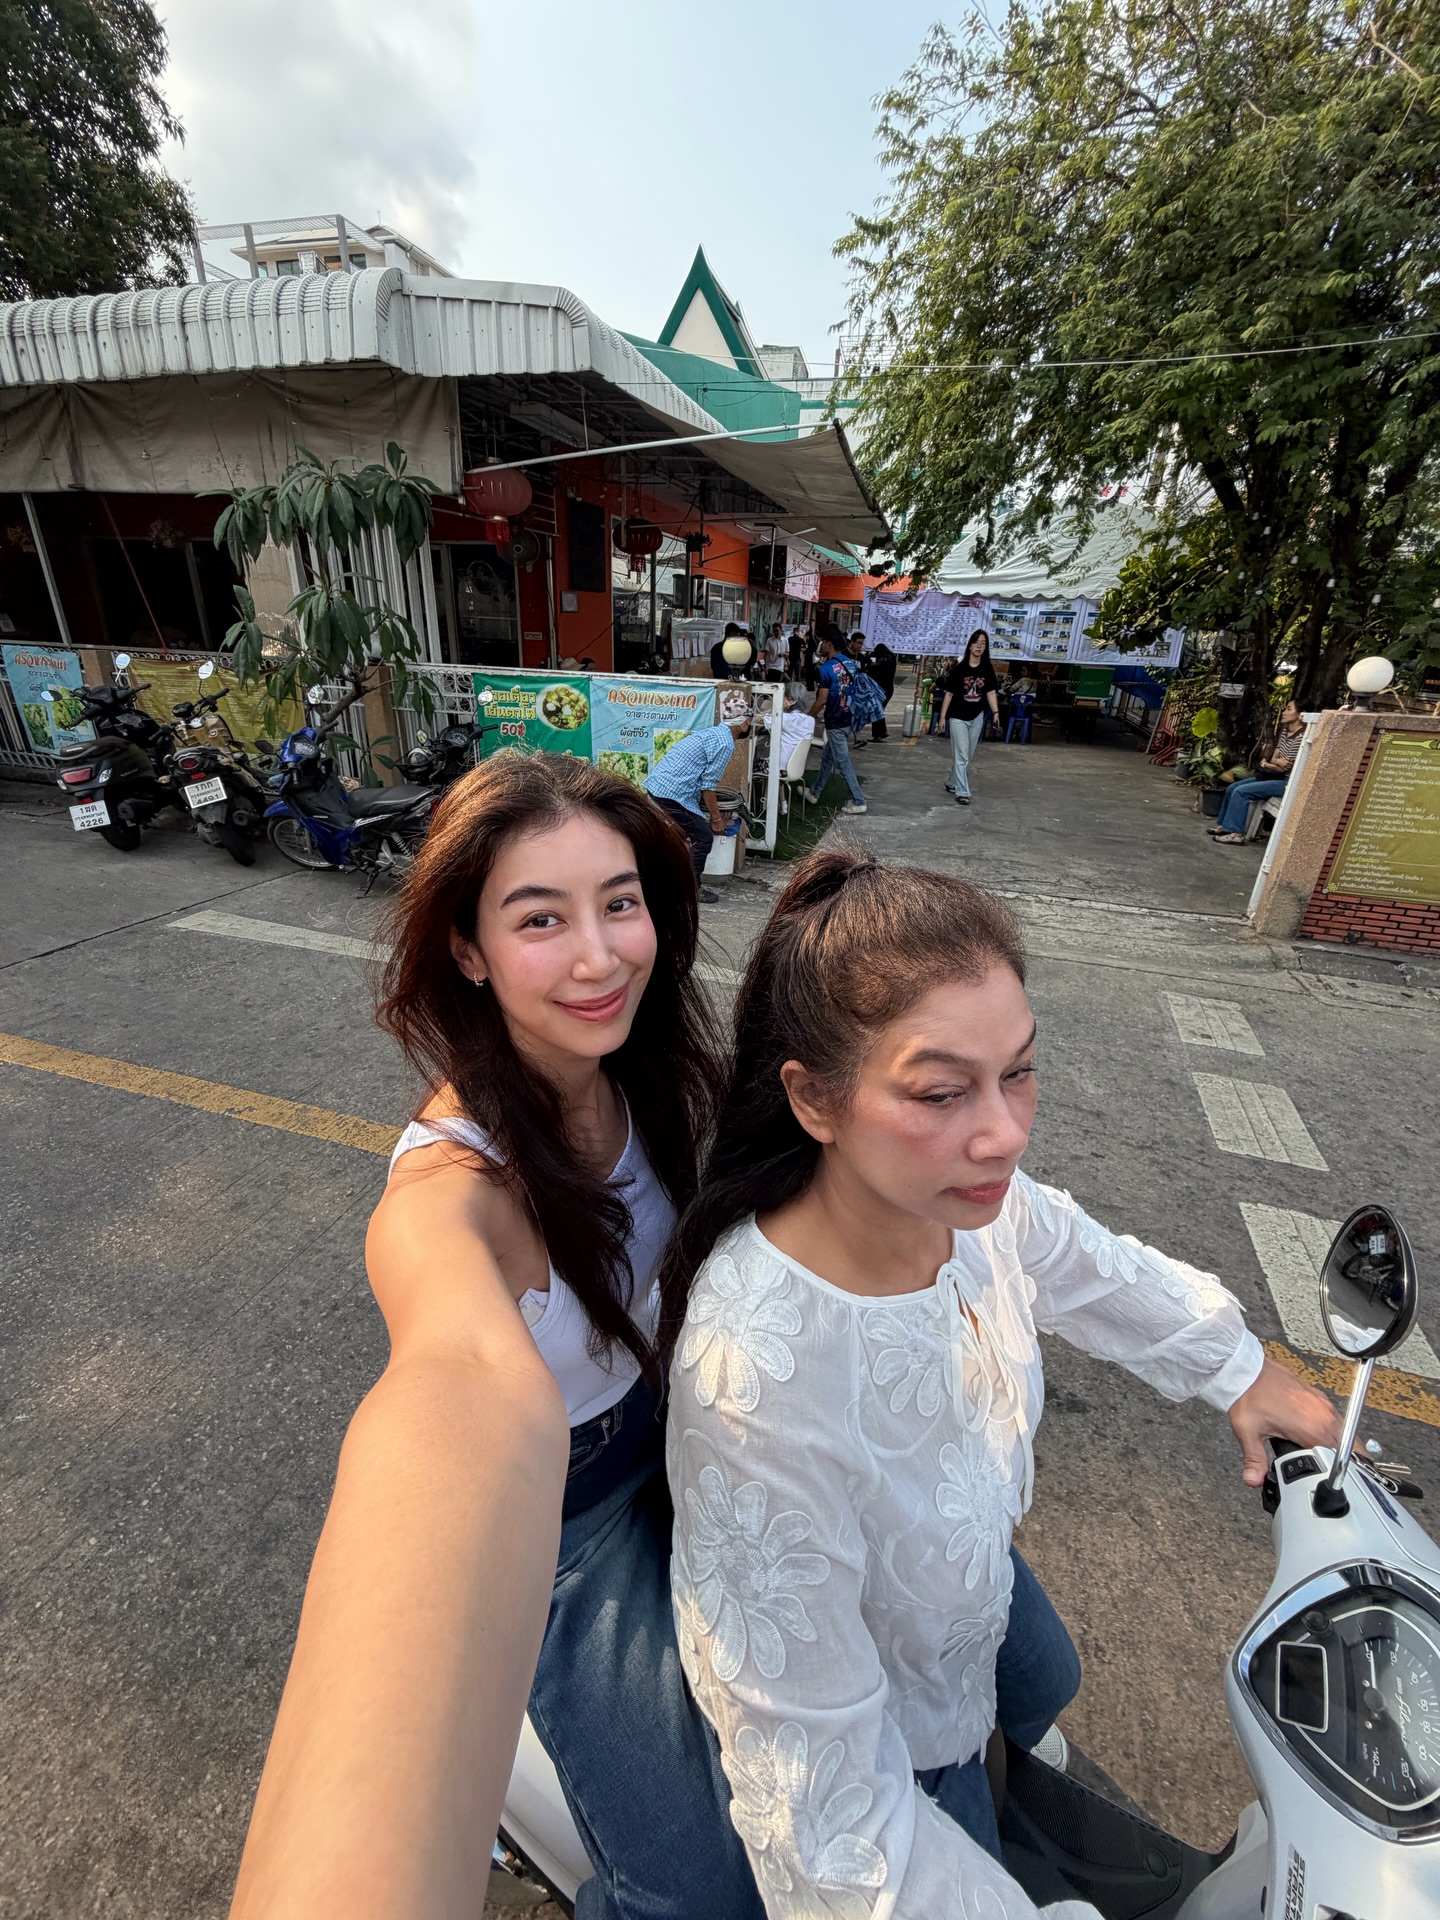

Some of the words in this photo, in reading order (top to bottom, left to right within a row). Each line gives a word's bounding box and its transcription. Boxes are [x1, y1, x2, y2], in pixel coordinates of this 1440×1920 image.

[608, 684, 698, 710] ครัวการะเกด
[625, 708, 678, 722] อาหารตามสั่ง
[80, 817, 104, 828] 4226
[1419, 1699, 1429, 1712] 60
[1422, 1720, 1431, 1734] 80
[1418, 1743, 1428, 1761] 100
